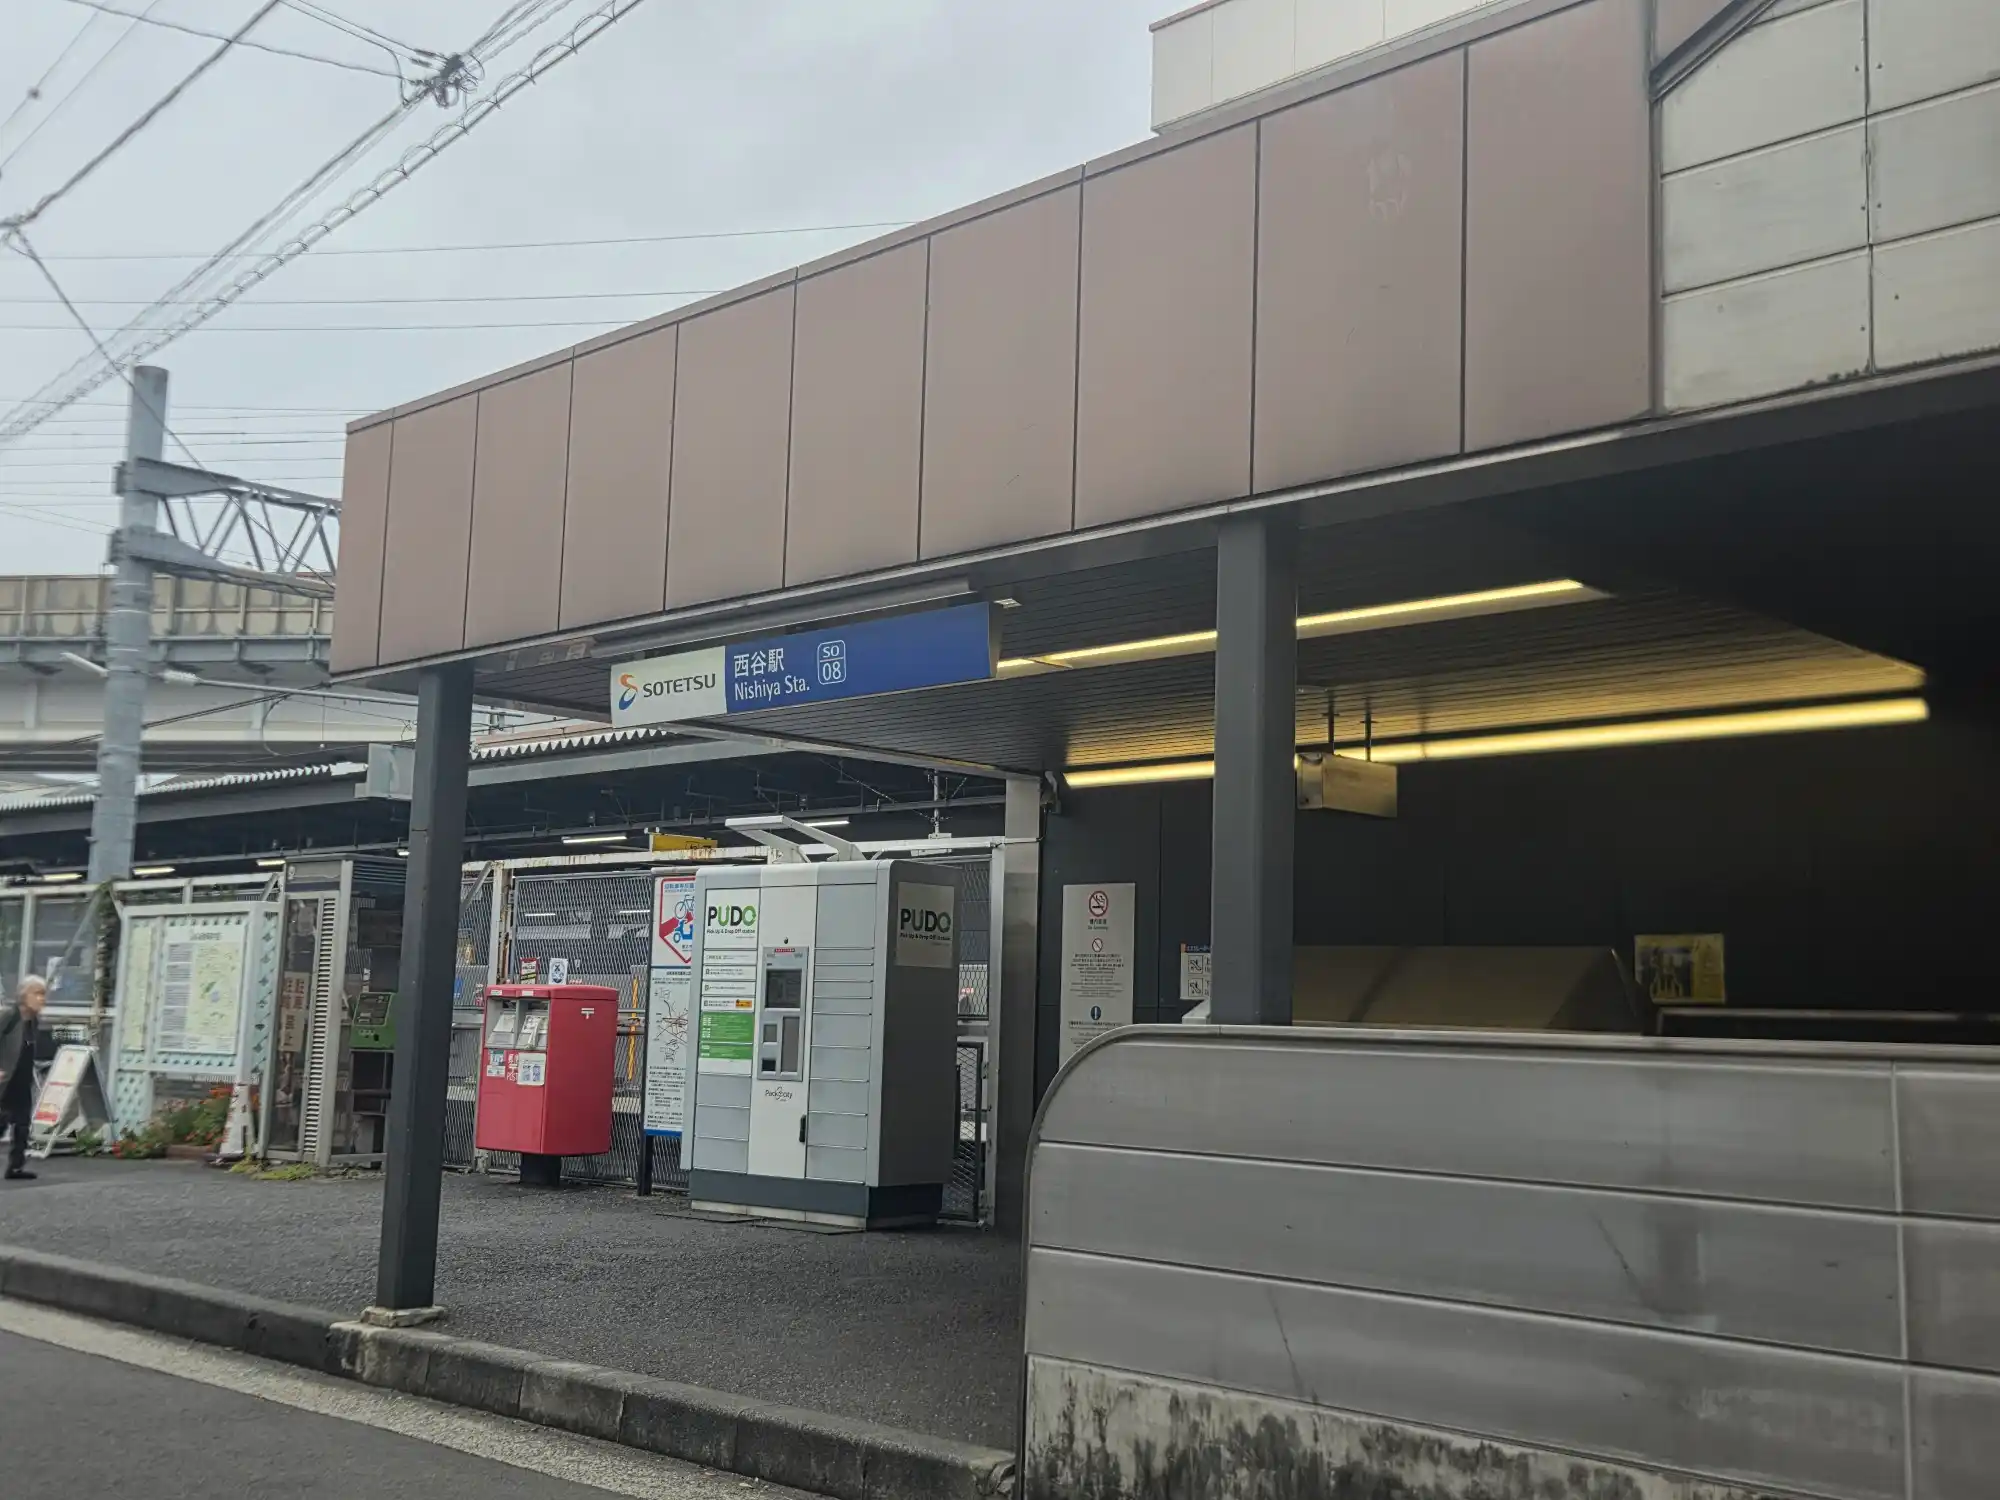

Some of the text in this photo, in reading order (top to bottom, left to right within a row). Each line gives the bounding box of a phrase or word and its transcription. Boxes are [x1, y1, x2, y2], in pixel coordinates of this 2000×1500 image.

[733, 648, 785, 678] 西谷駅
[823, 645, 840, 658] SO
[822, 661, 842, 681] 08
[642, 673, 716, 698] SOTETSU
[734, 674, 811, 701] Nishiya Sta.
[707, 905, 757, 927] PUDO
[900, 908, 951, 933] PUDO
